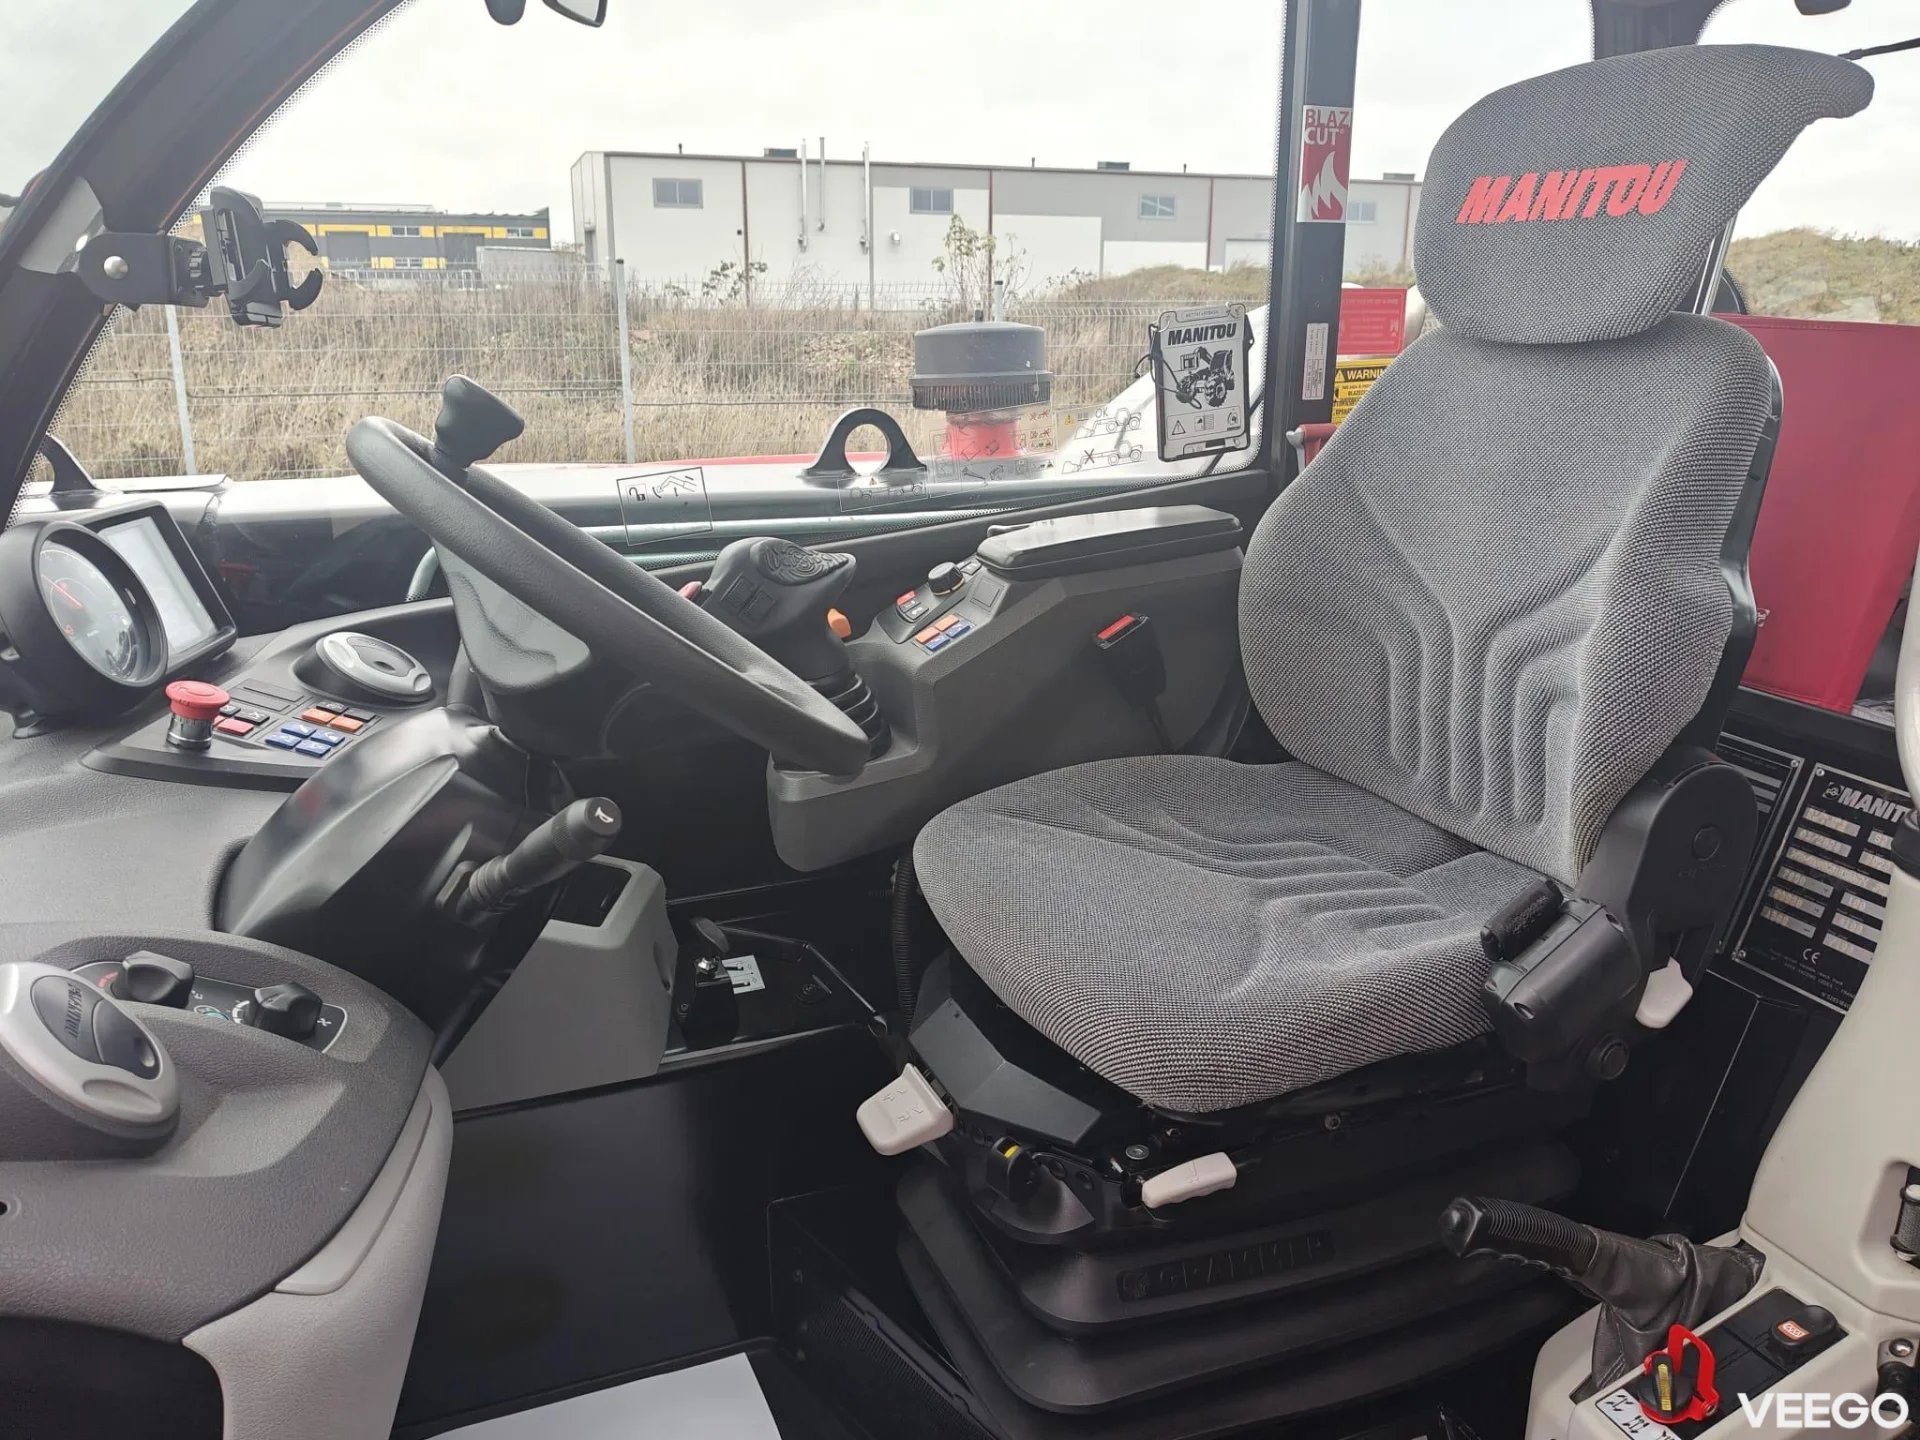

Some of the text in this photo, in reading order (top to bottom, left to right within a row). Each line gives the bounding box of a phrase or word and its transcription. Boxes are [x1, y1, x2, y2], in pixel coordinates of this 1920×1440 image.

[1305, 109, 1352, 128] BLAZ
[1304, 127, 1340, 146] CUT
[1456, 160, 1689, 226] MANITOU
[1167, 323, 1237, 346] MANITOU
[1095, 408, 1109, 419] OK
[1838, 788, 1909, 823] MANIT
